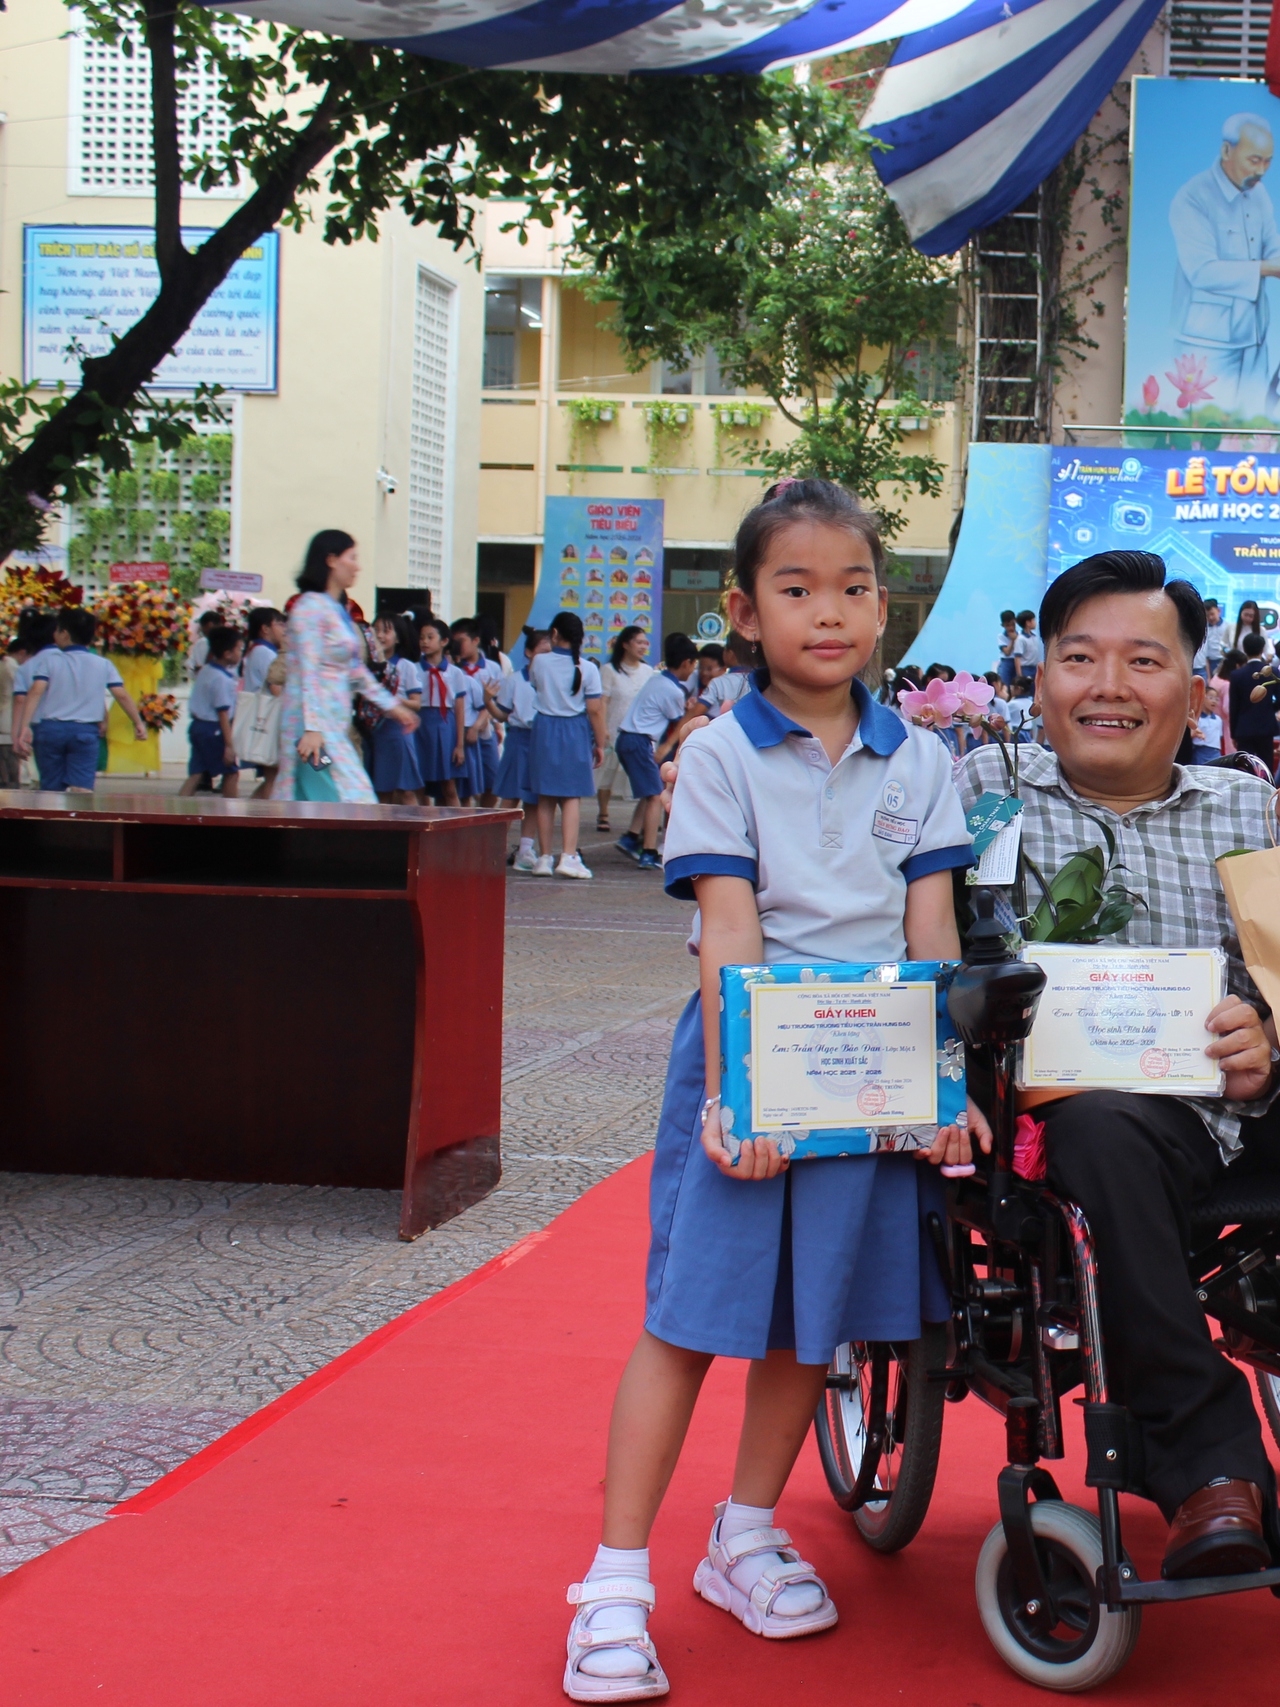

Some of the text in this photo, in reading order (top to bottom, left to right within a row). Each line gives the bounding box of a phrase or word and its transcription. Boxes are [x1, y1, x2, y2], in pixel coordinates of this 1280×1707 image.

[1054, 459, 1104, 485] Happy
[1166, 457, 1206, 495] LỄ
[587, 504, 641, 517] GIÁO VIÊN
[1175, 501, 1219, 520] NĂM
[1222, 503, 1264, 522] HỌC
[1233, 543, 1267, 558] TRẦN
[887, 793, 899, 808] 05
[1089, 970, 1154, 982] GIẤY KHEN
[814, 1006, 876, 1018] GIẤY KHEN
